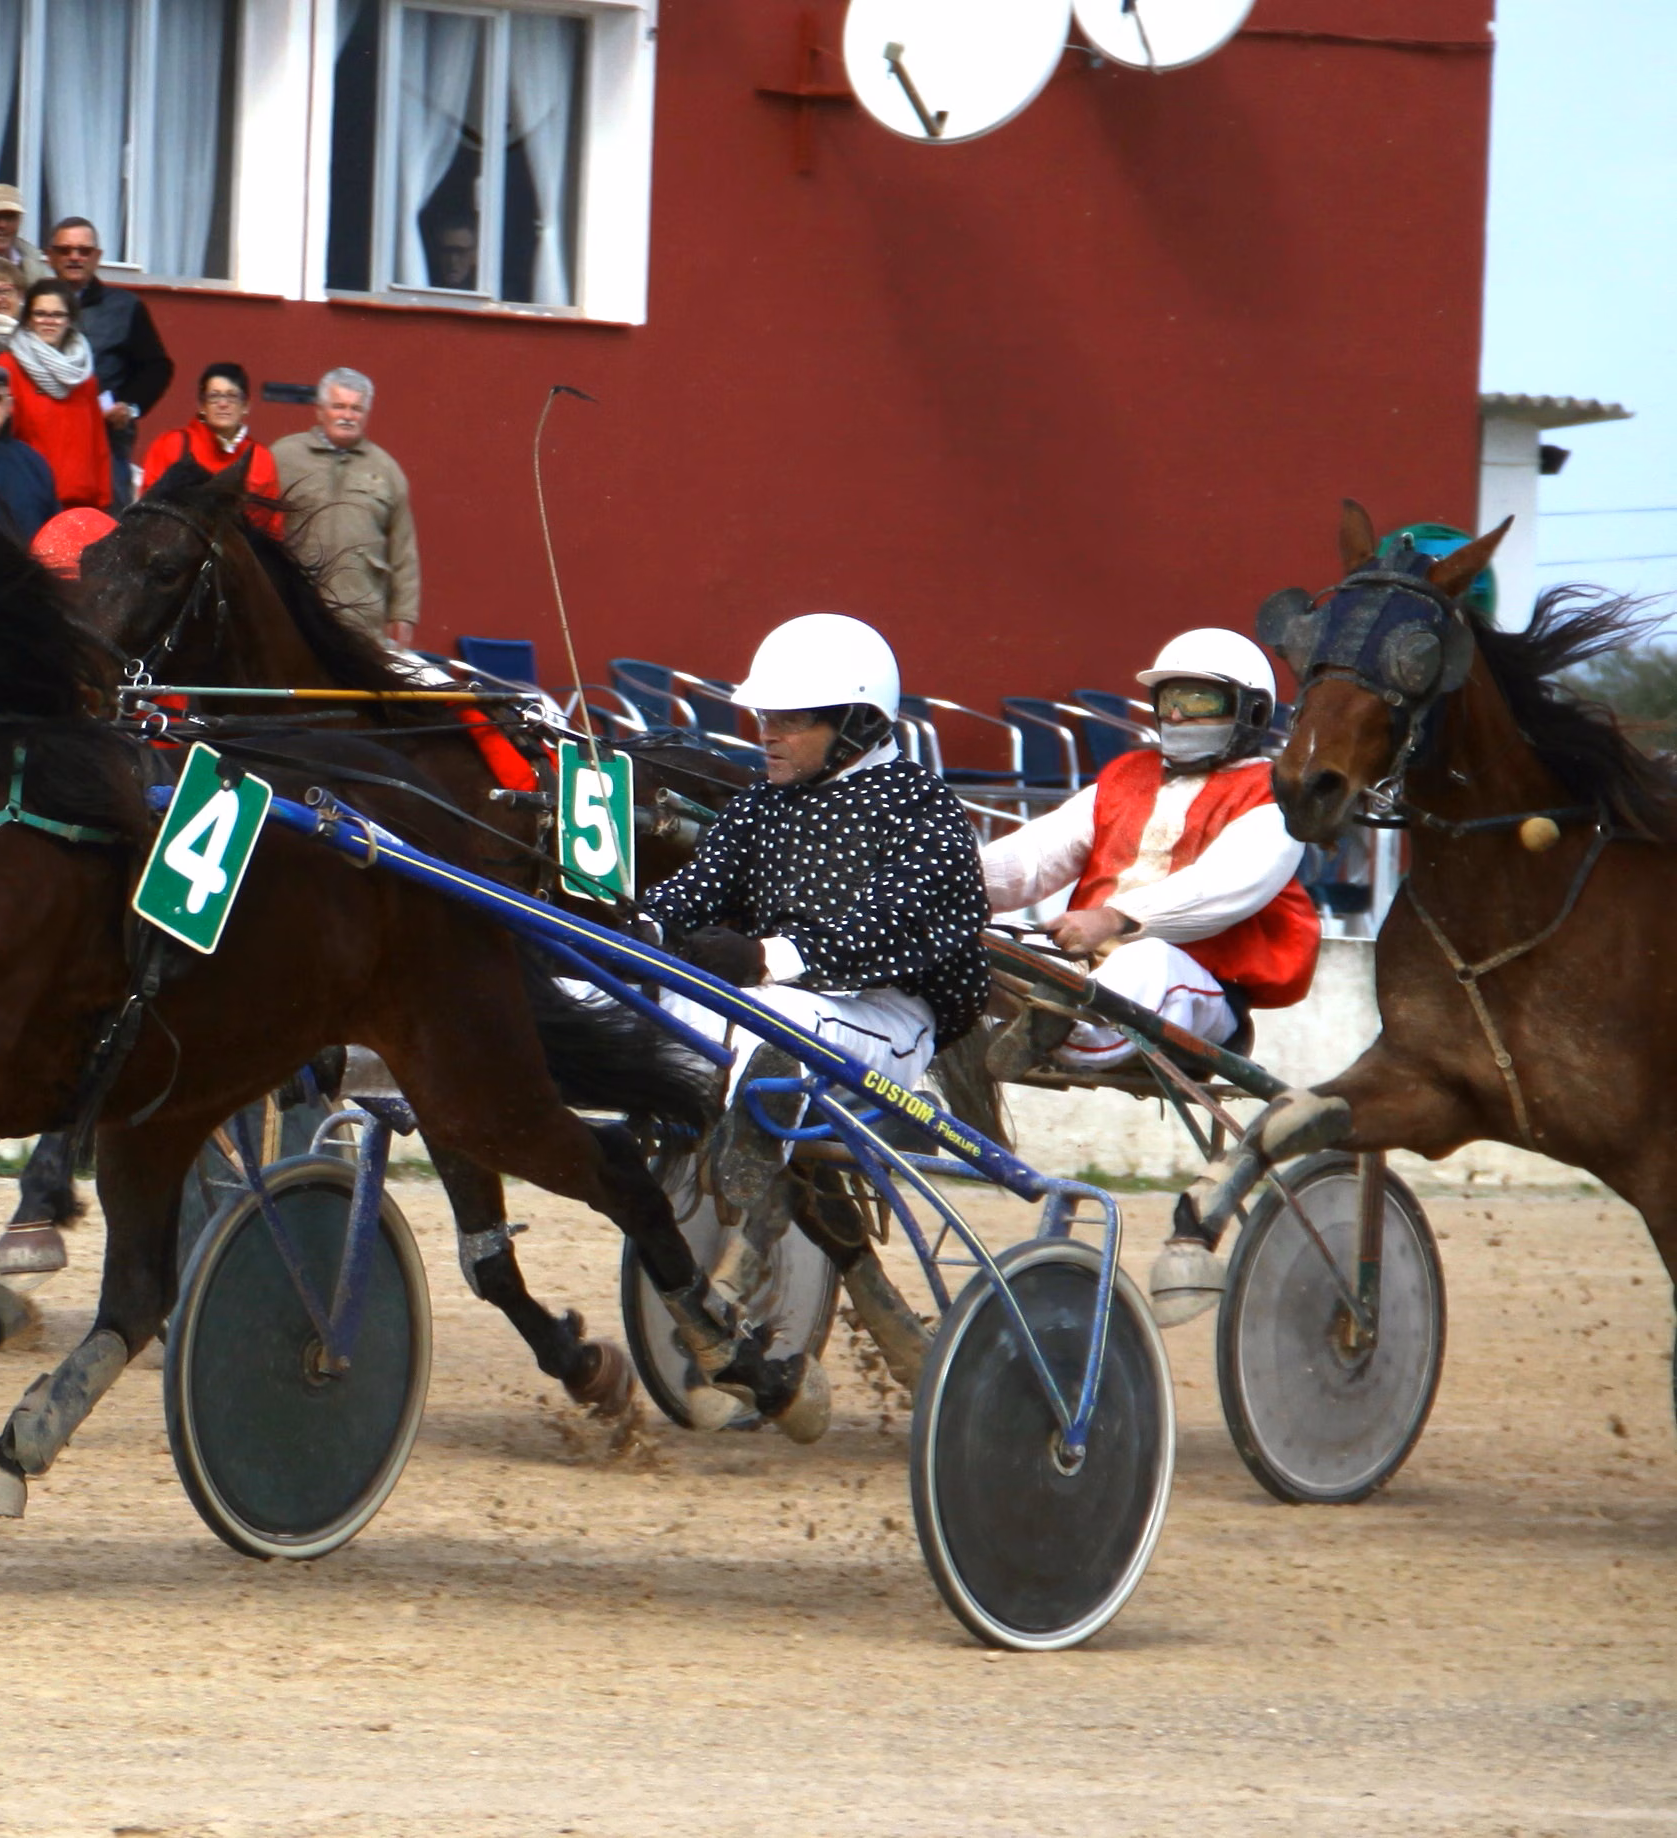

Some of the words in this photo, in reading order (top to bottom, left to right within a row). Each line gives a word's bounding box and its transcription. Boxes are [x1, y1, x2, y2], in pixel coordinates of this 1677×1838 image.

[164, 788, 240, 914] 4
[574, 768, 619, 876] 5
[863, 1070, 935, 1126] CUSTOM
